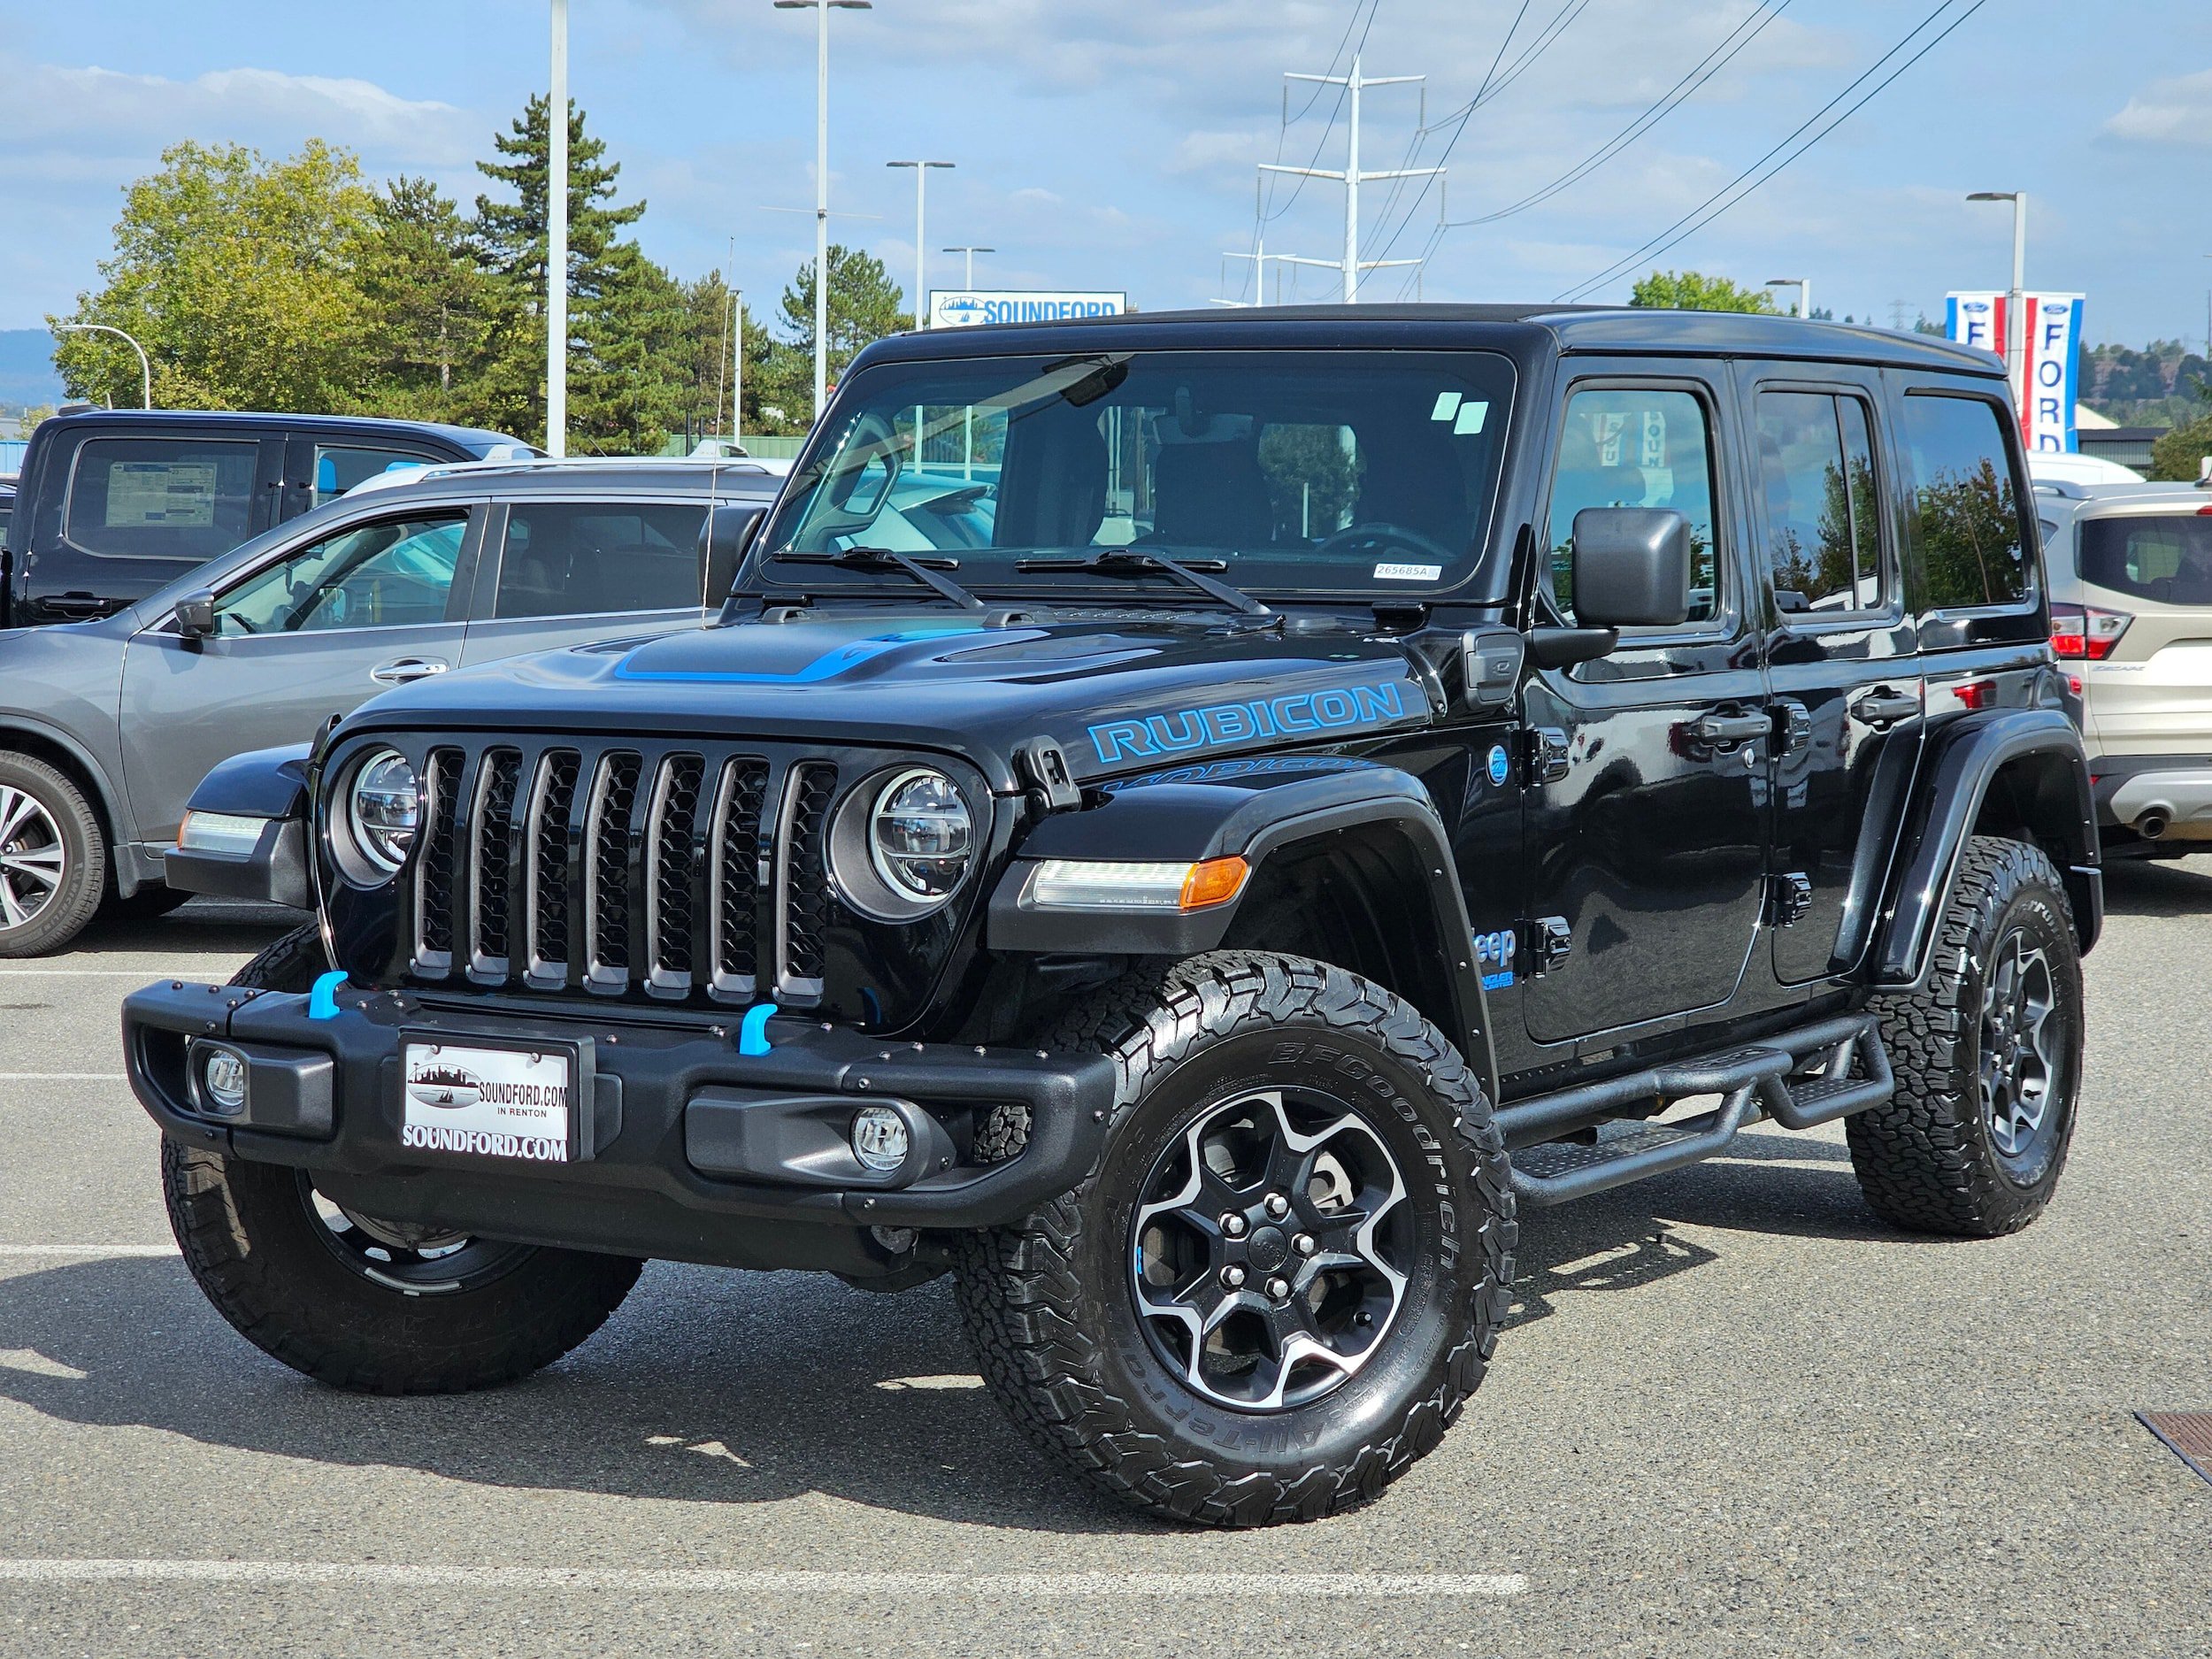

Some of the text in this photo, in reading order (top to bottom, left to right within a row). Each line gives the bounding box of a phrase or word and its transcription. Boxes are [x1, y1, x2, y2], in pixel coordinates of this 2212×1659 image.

[984, 300, 1116, 325] SOUNDFORD
[1377, 565, 1428, 576] 265685A
[1087, 682, 1405, 764] RUBICON
[1473, 929, 1517, 968] eep
[479, 1081, 568, 1109] SOUNDFORD.COM
[497, 1106, 547, 1119] IN RENTON
[403, 1124, 568, 1163] SOUNDFORD.COM
[1267, 1041, 1462, 1271] BFGoodrich
